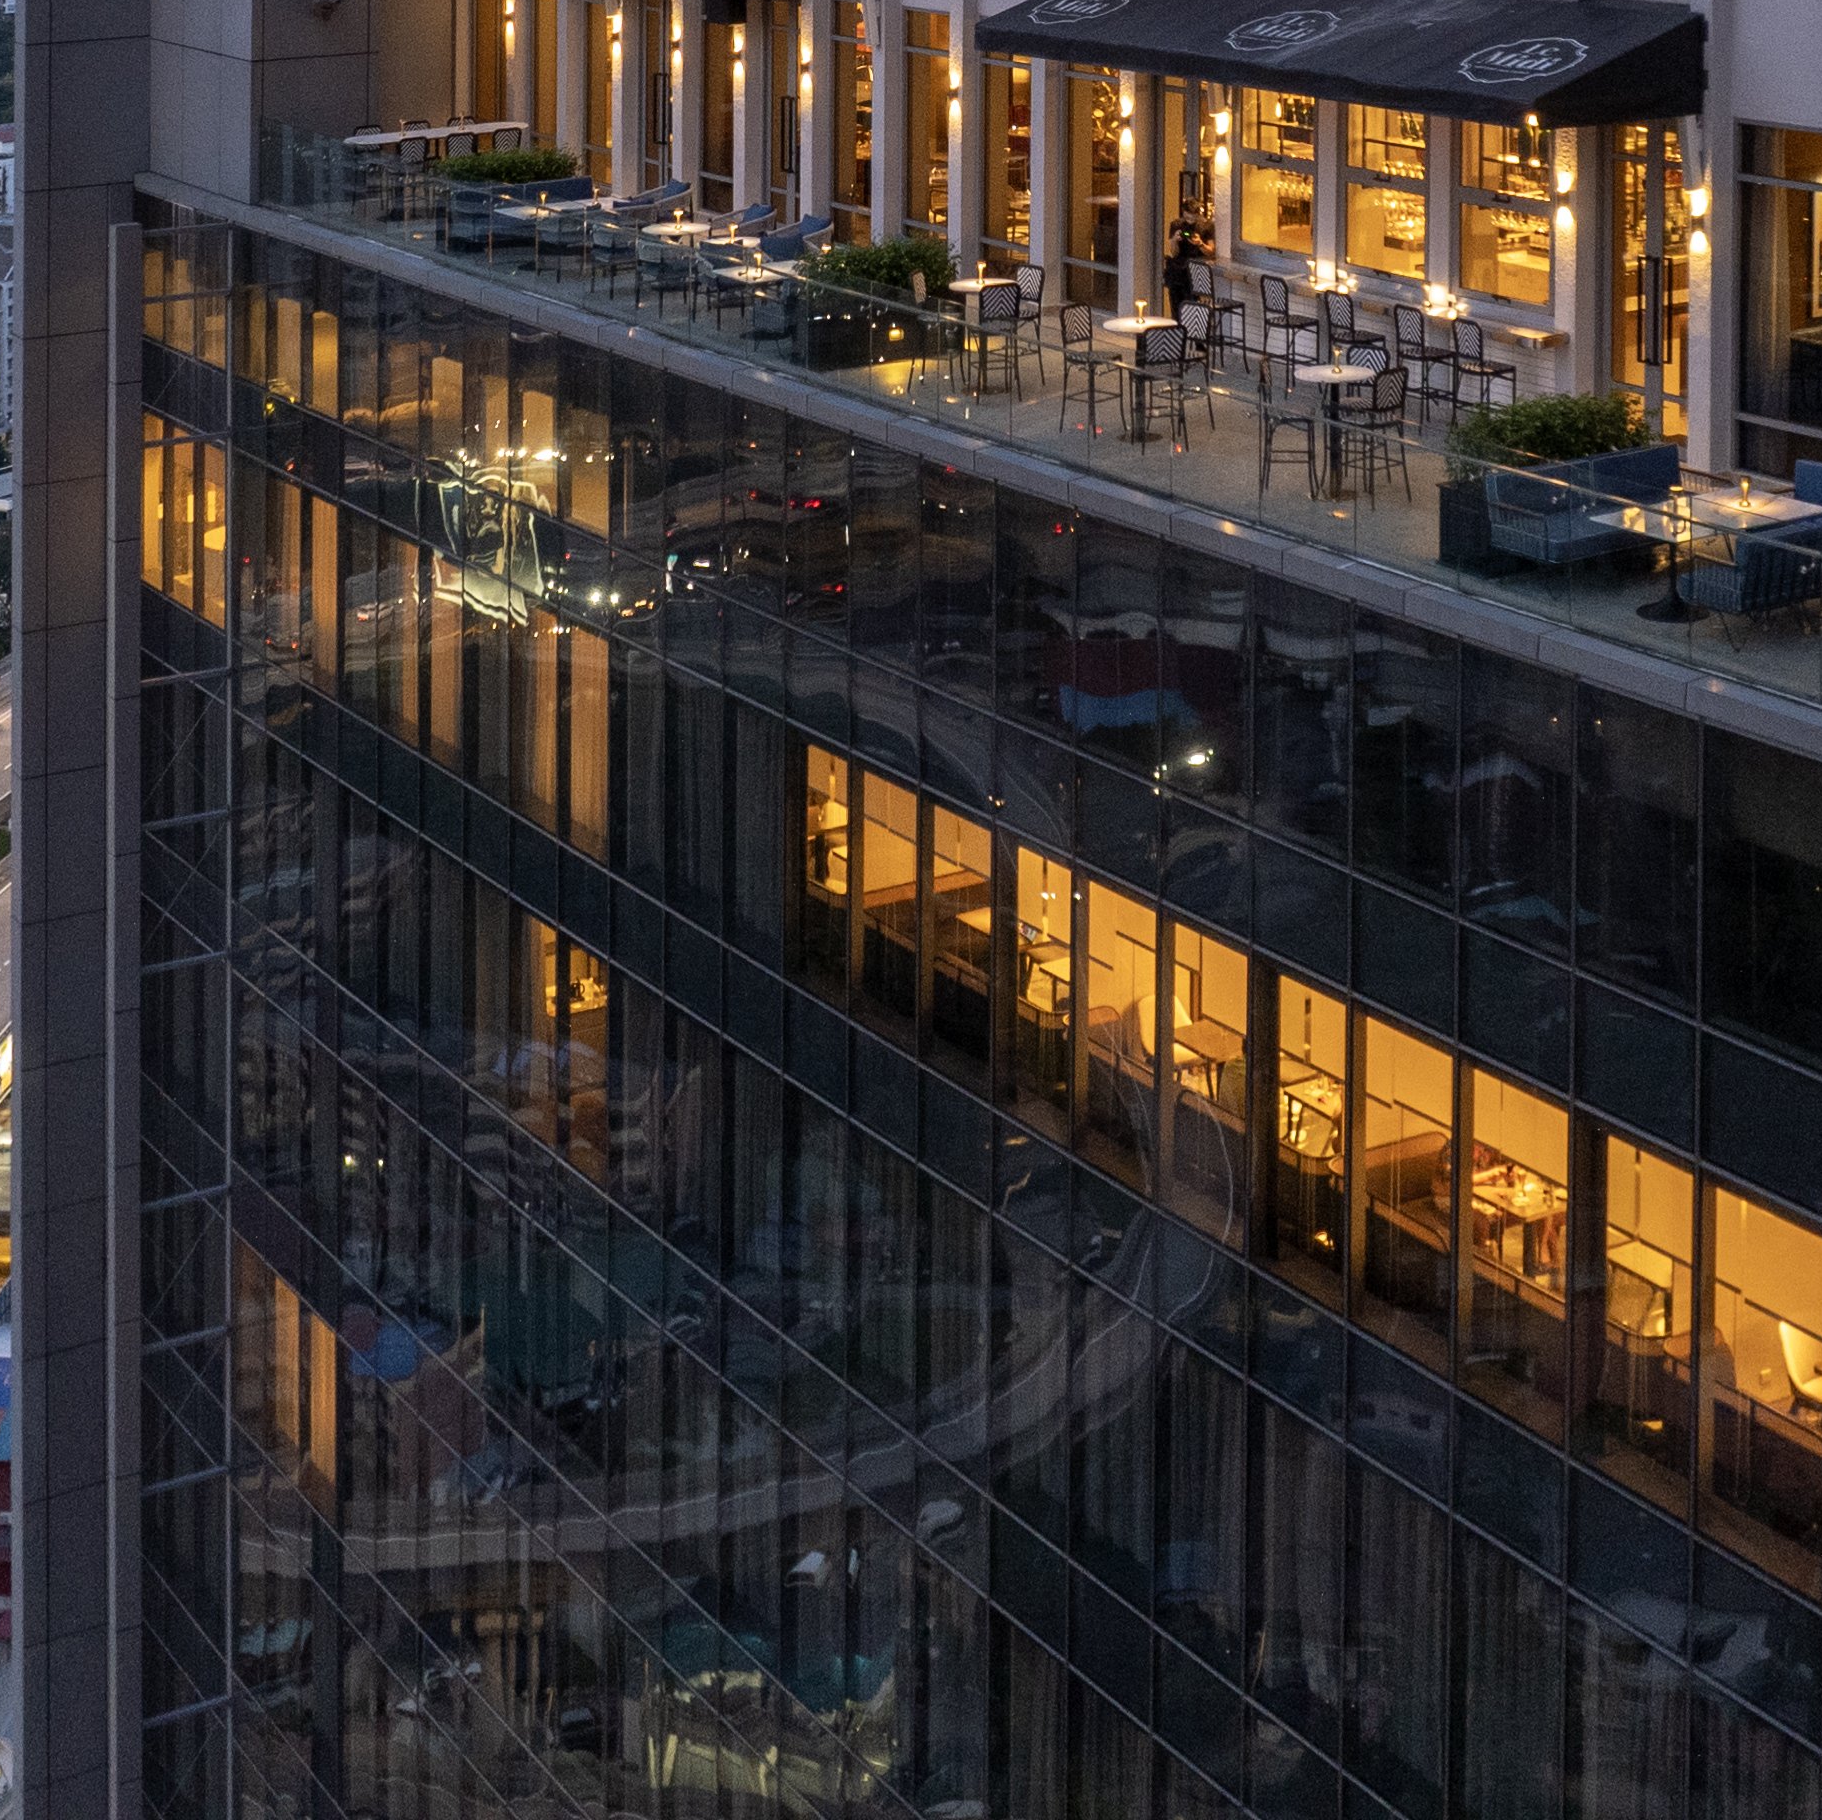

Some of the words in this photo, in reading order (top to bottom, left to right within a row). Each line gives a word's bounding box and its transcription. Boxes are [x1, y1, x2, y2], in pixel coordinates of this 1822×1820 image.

[1245, 23, 1316, 40] Midi
[1522, 44, 1560, 56] Le
[1477, 52, 1562, 70] Midi
